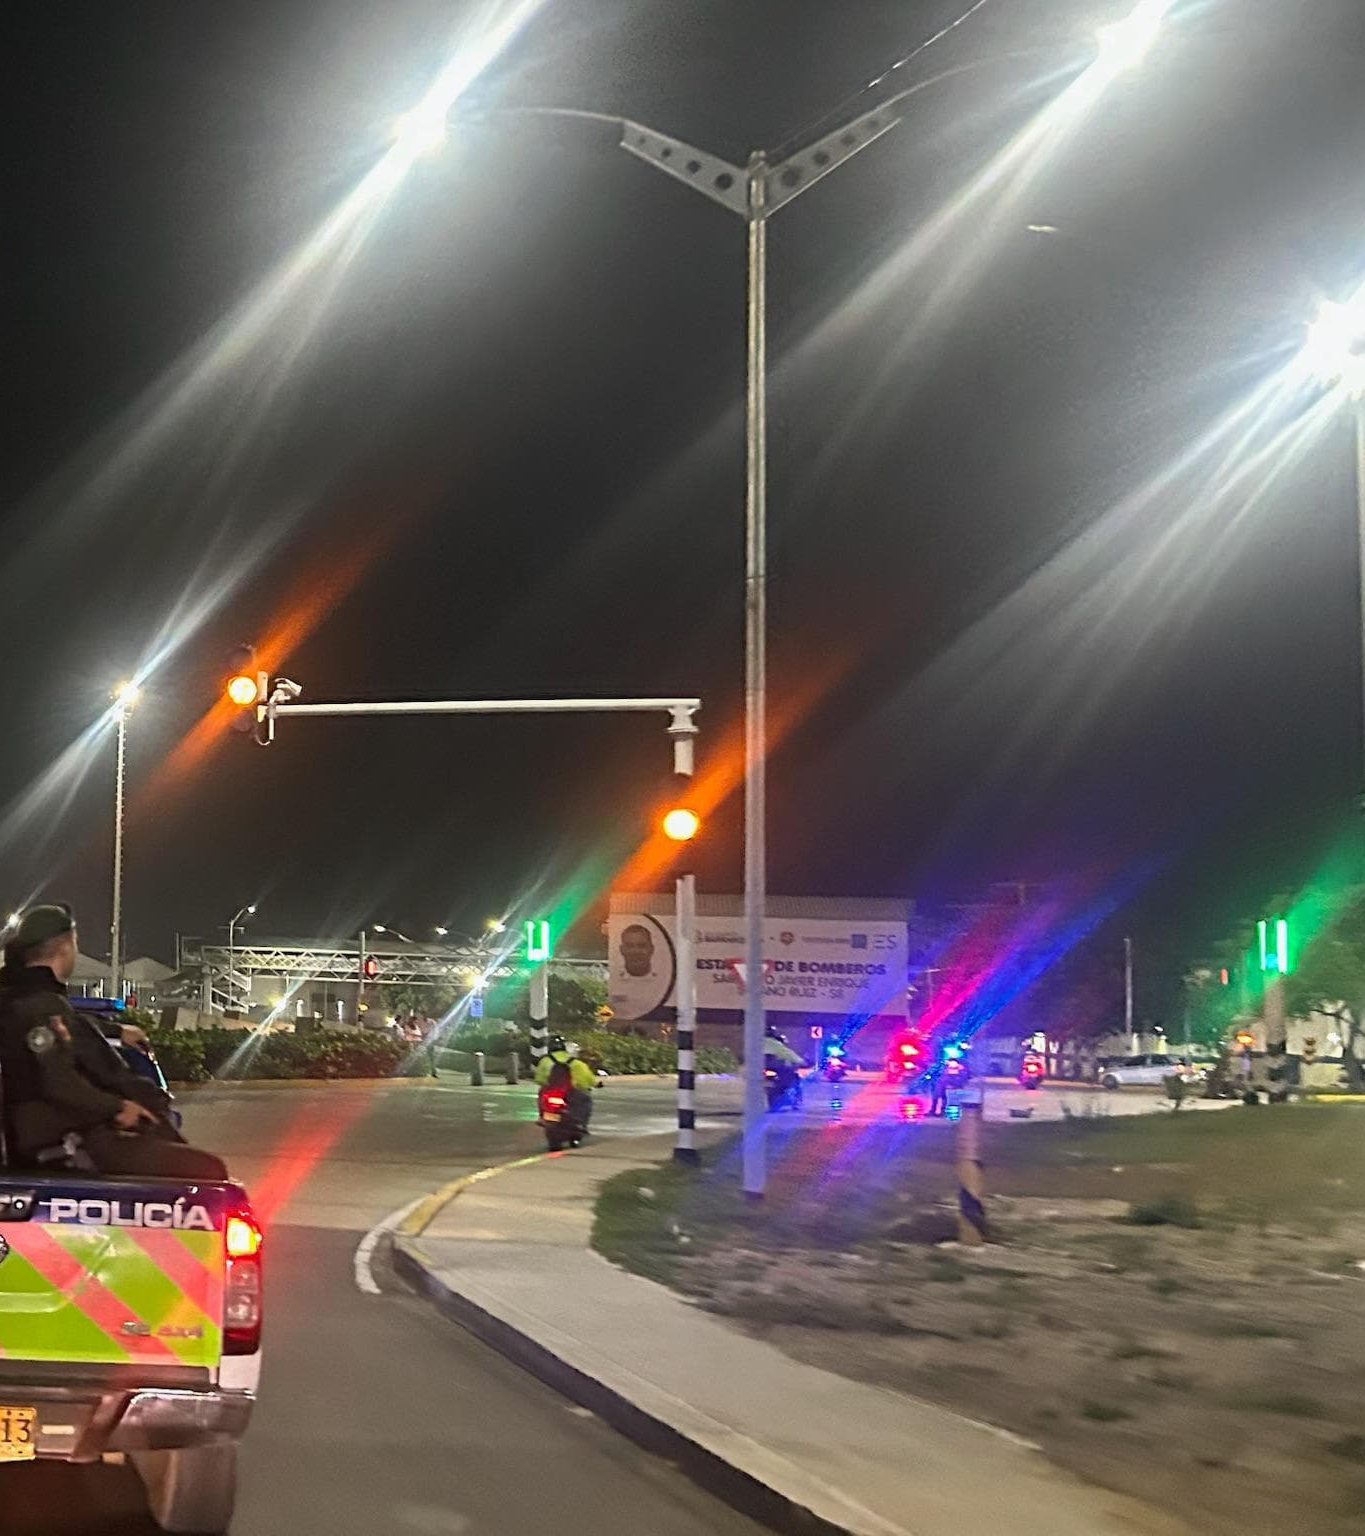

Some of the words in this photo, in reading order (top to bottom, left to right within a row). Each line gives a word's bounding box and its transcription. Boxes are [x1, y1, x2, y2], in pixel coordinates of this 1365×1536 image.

[774, 960, 794, 972] DE
[798, 961, 886, 975] BOMBEROS
[49, 1196, 215, 1231] POLICÍA
